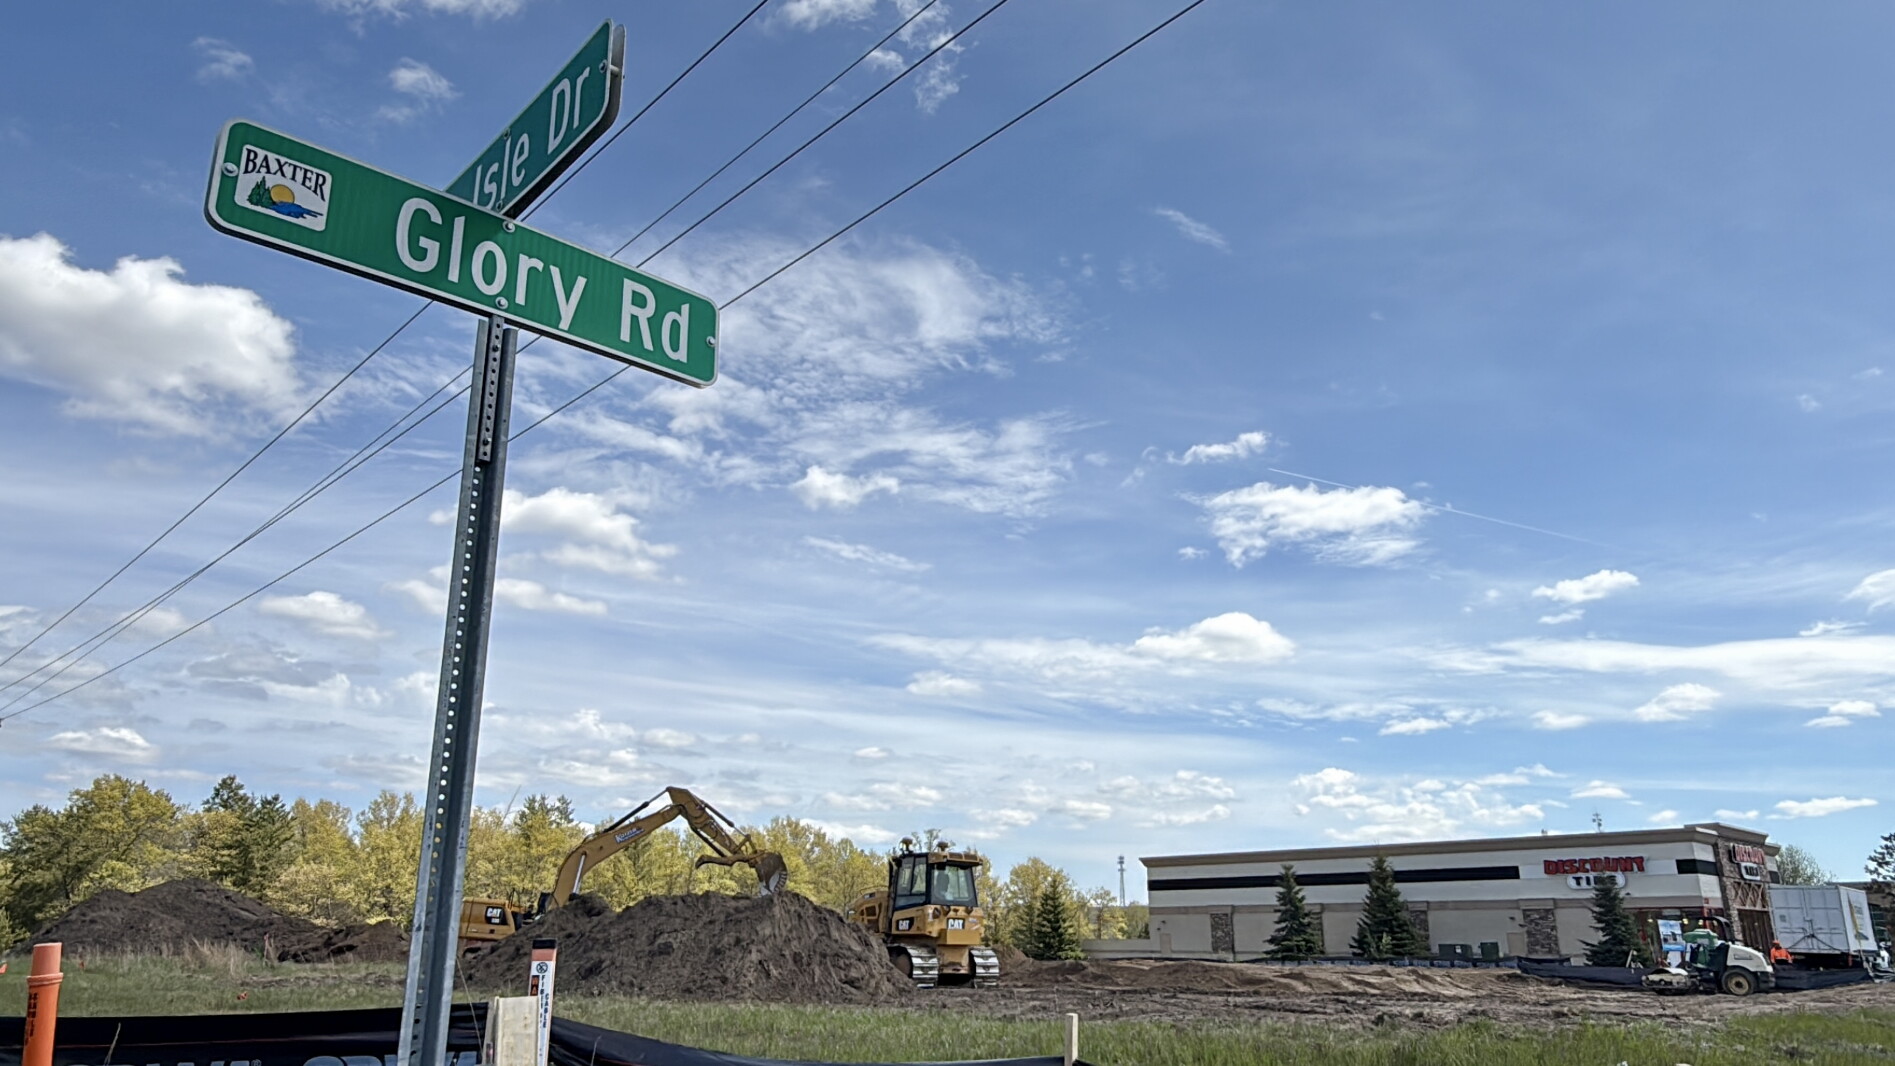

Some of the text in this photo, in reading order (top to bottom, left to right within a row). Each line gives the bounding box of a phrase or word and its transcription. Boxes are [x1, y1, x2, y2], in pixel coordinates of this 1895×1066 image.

[472, 64, 590, 212] Isle Dr
[243, 147, 329, 202] BAXTER
[395, 197, 691, 364] Glory Rd
[1543, 856, 1645, 875] DISCOUNT
[486, 907, 502, 917] CAT
[898, 919, 910, 930] CAT
[948, 918, 963, 930] CAT
[542, 993, 550, 1028] CABLE
